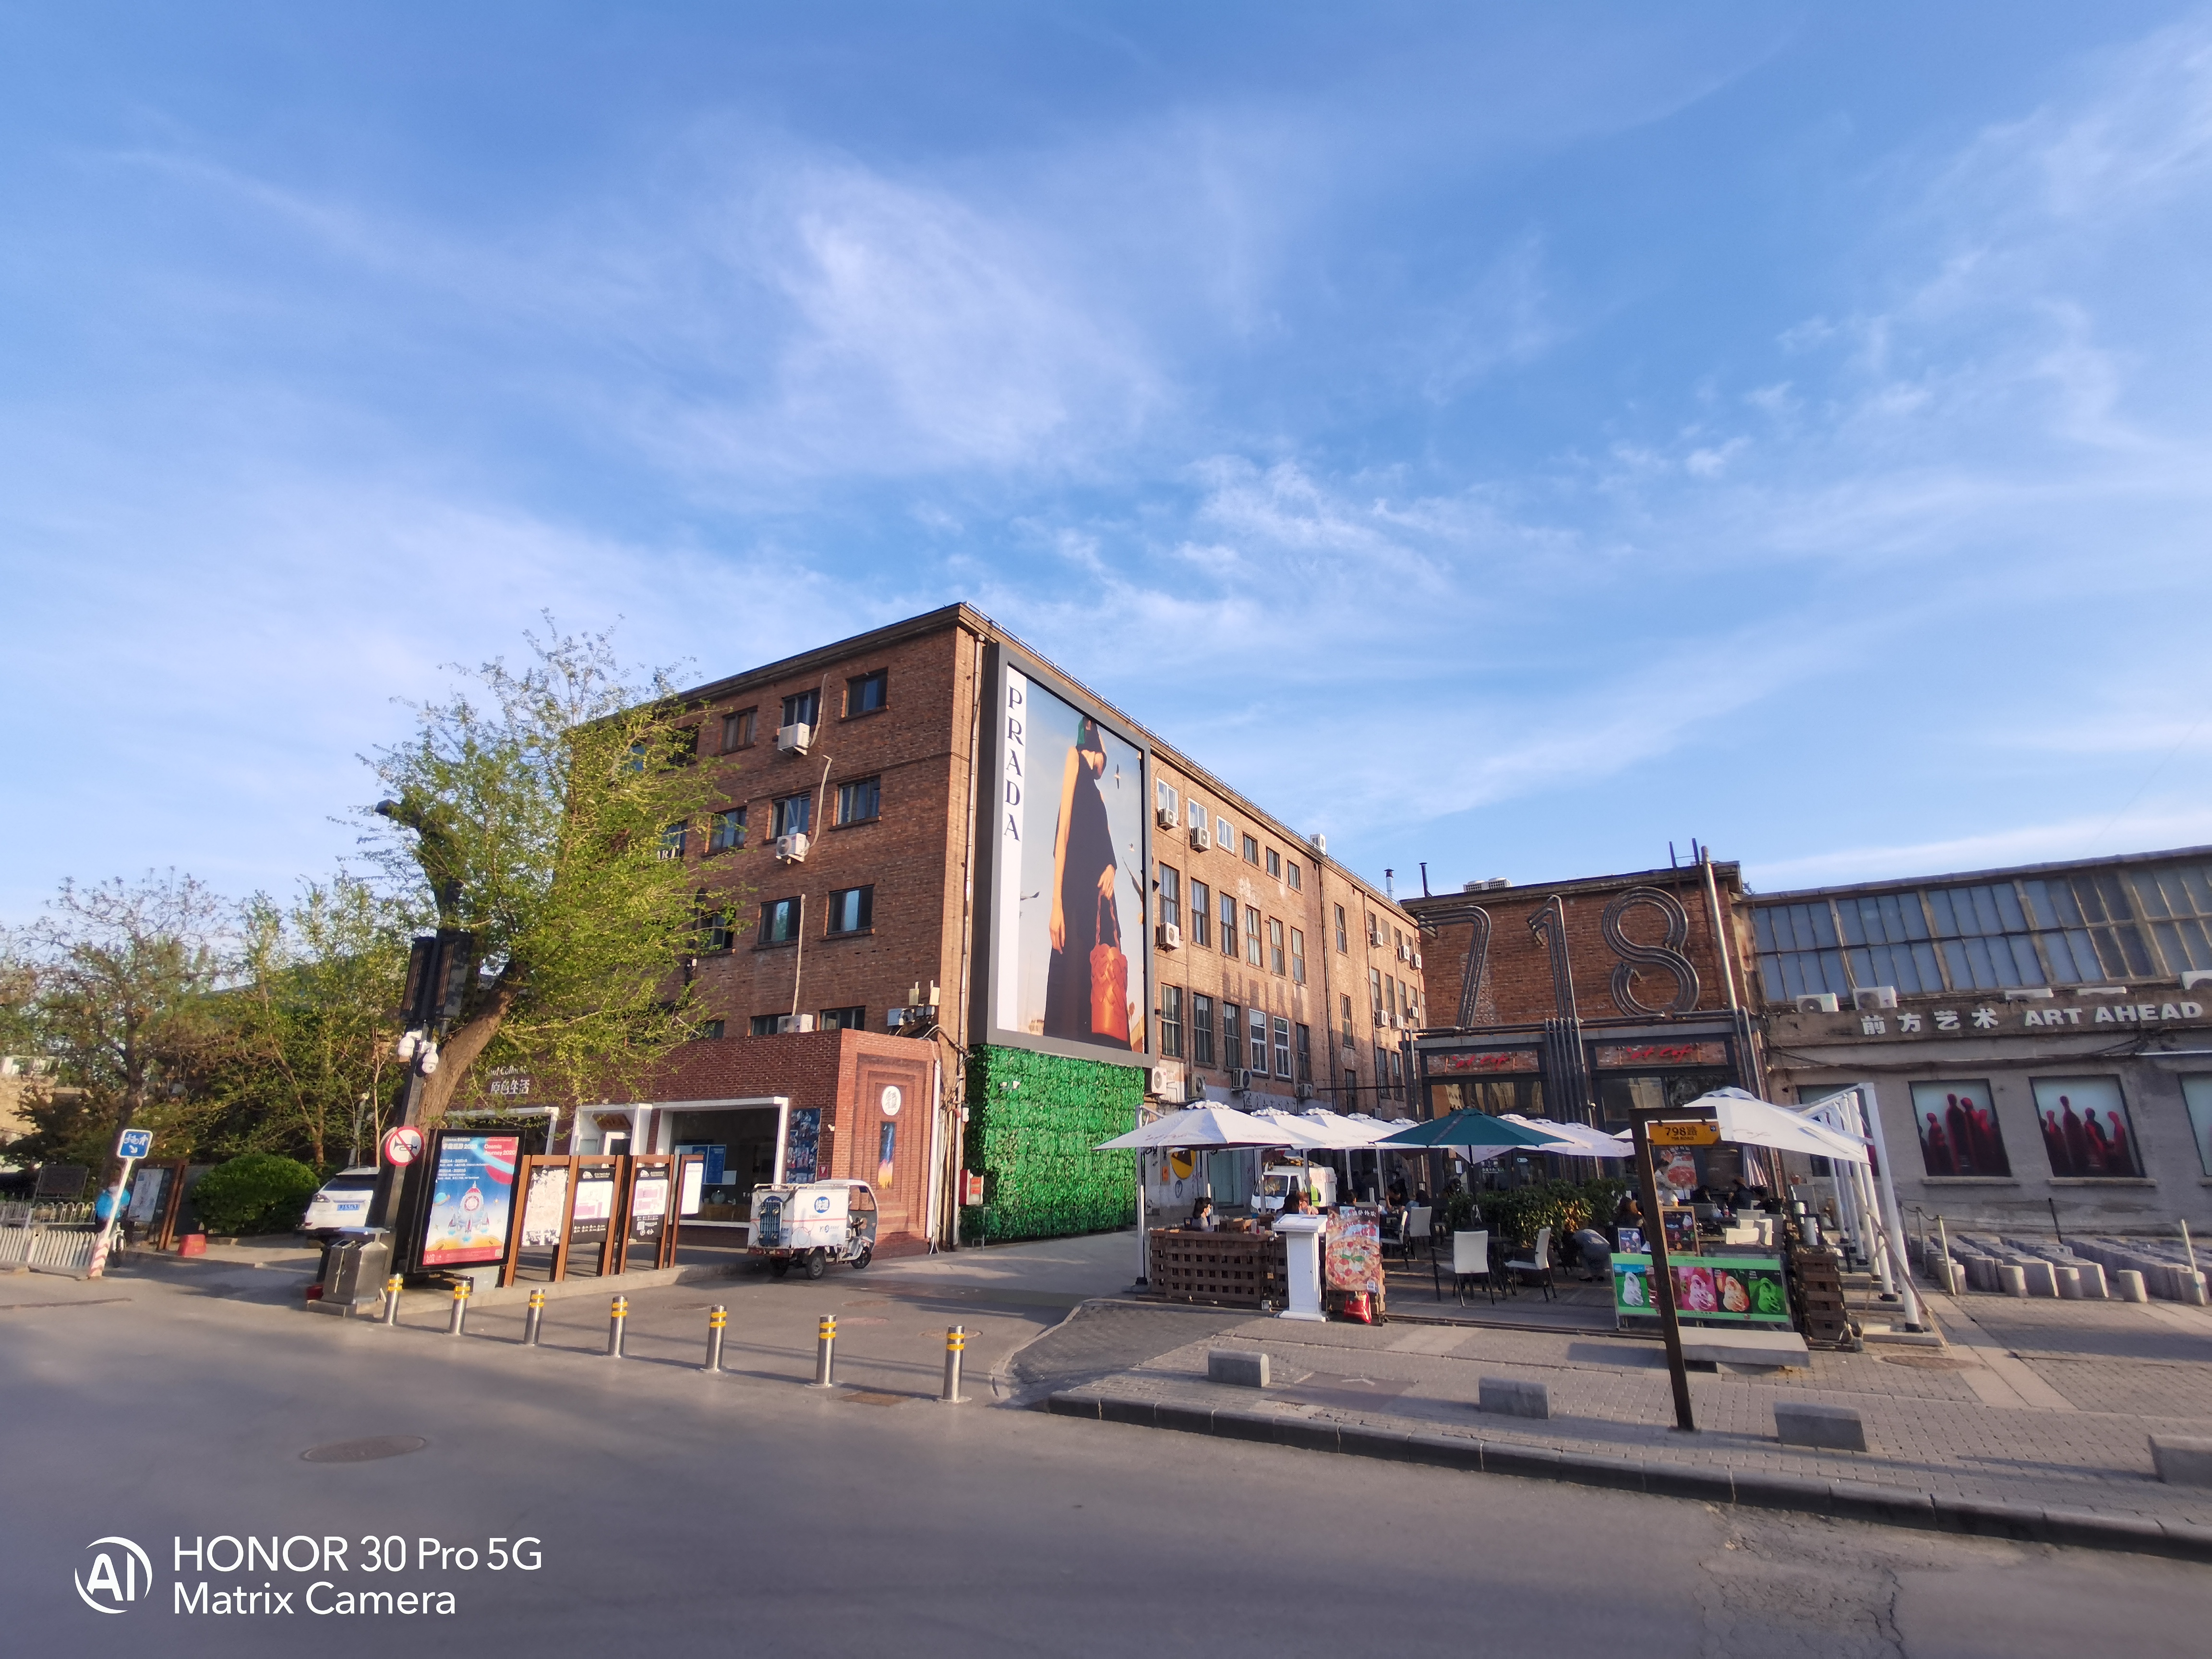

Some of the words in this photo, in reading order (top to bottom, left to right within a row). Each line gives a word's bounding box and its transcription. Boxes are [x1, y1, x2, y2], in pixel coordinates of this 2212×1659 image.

[1003, 684, 1024, 842] PRADA
[1418, 886, 1700, 1028] 718
[1861, 1008, 1999, 1035] 前方艺术
[2024, 1008, 2083, 1026] ART
[2094, 1001, 2203, 1023] AHEAD
[1664, 1126, 1697, 1136] 798路
